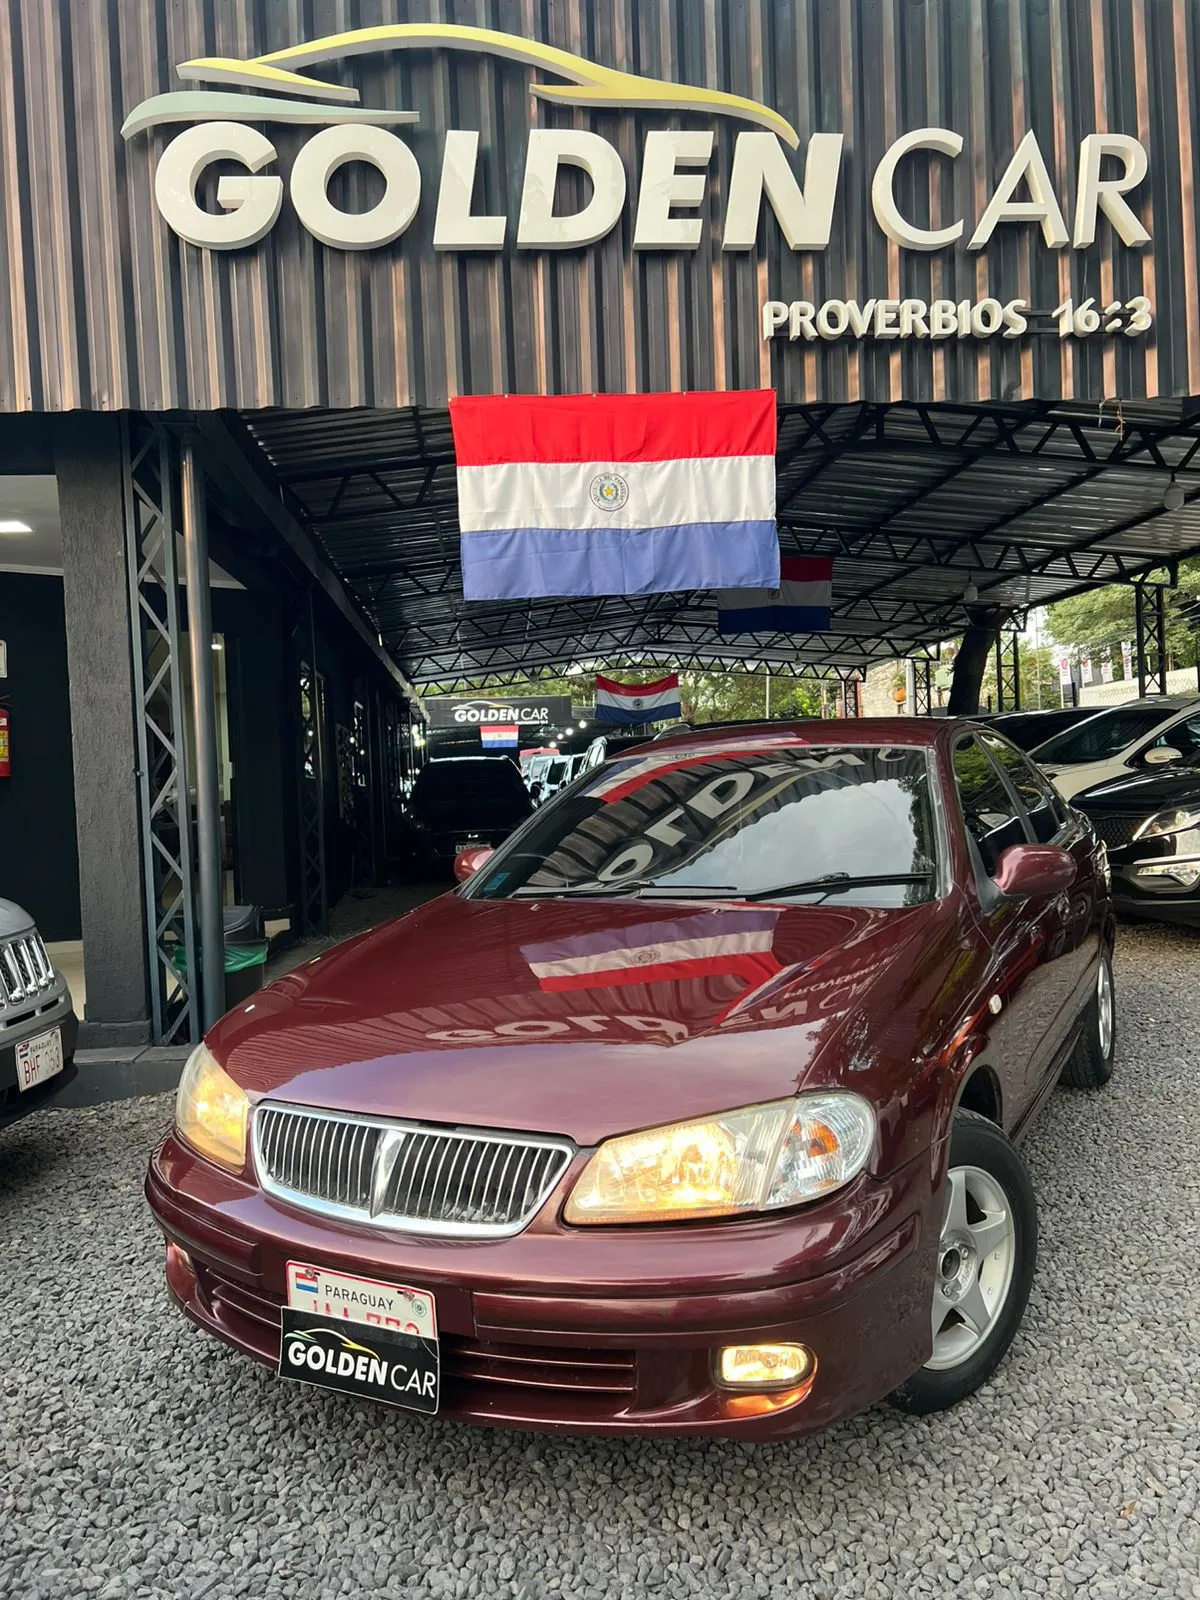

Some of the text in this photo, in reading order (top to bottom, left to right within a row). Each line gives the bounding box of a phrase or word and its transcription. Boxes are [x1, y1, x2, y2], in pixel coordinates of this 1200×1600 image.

[155, 120, 1152, 251] GOLDEN CAR
[763, 295, 1153, 341] PROVERBIOS 16:3
[454, 708, 519, 722] GOLDEN
[520, 707, 549, 720] CAR
[325, 1284, 394, 1311] PARAGUAY
[288, 1341, 437, 1399] GOLDEN CAR
